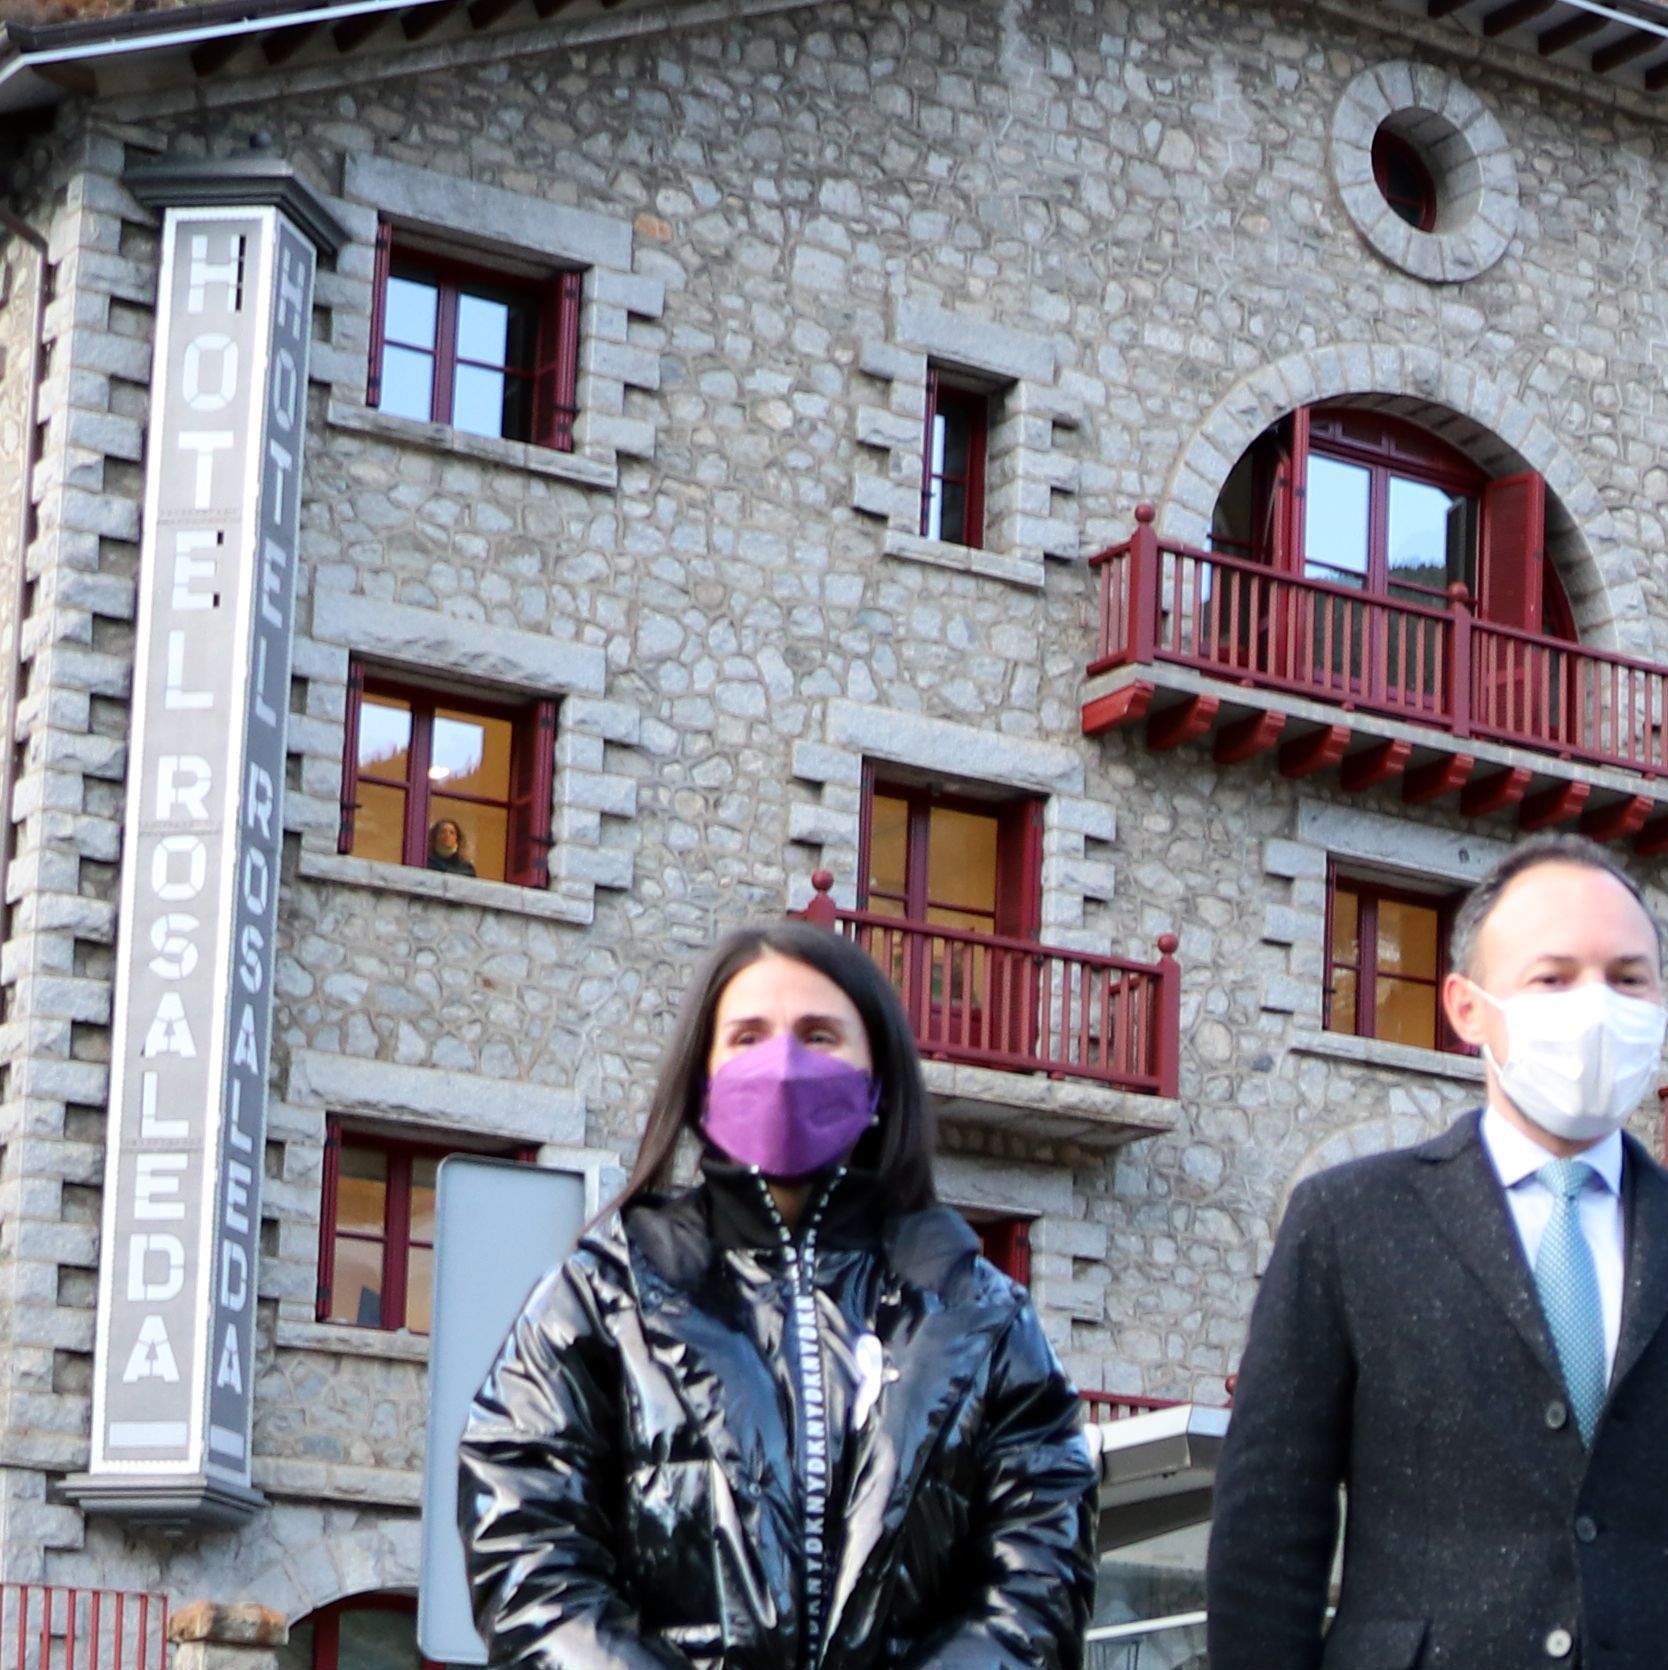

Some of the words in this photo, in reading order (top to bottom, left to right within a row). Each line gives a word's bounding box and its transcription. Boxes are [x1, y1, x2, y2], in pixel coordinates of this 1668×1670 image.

[165, 233, 247, 710] HOTEL
[255, 245, 307, 731] HOTEL
[122, 754, 212, 1383] ROSALEDA
[215, 758, 273, 1394] ROSALEDA
